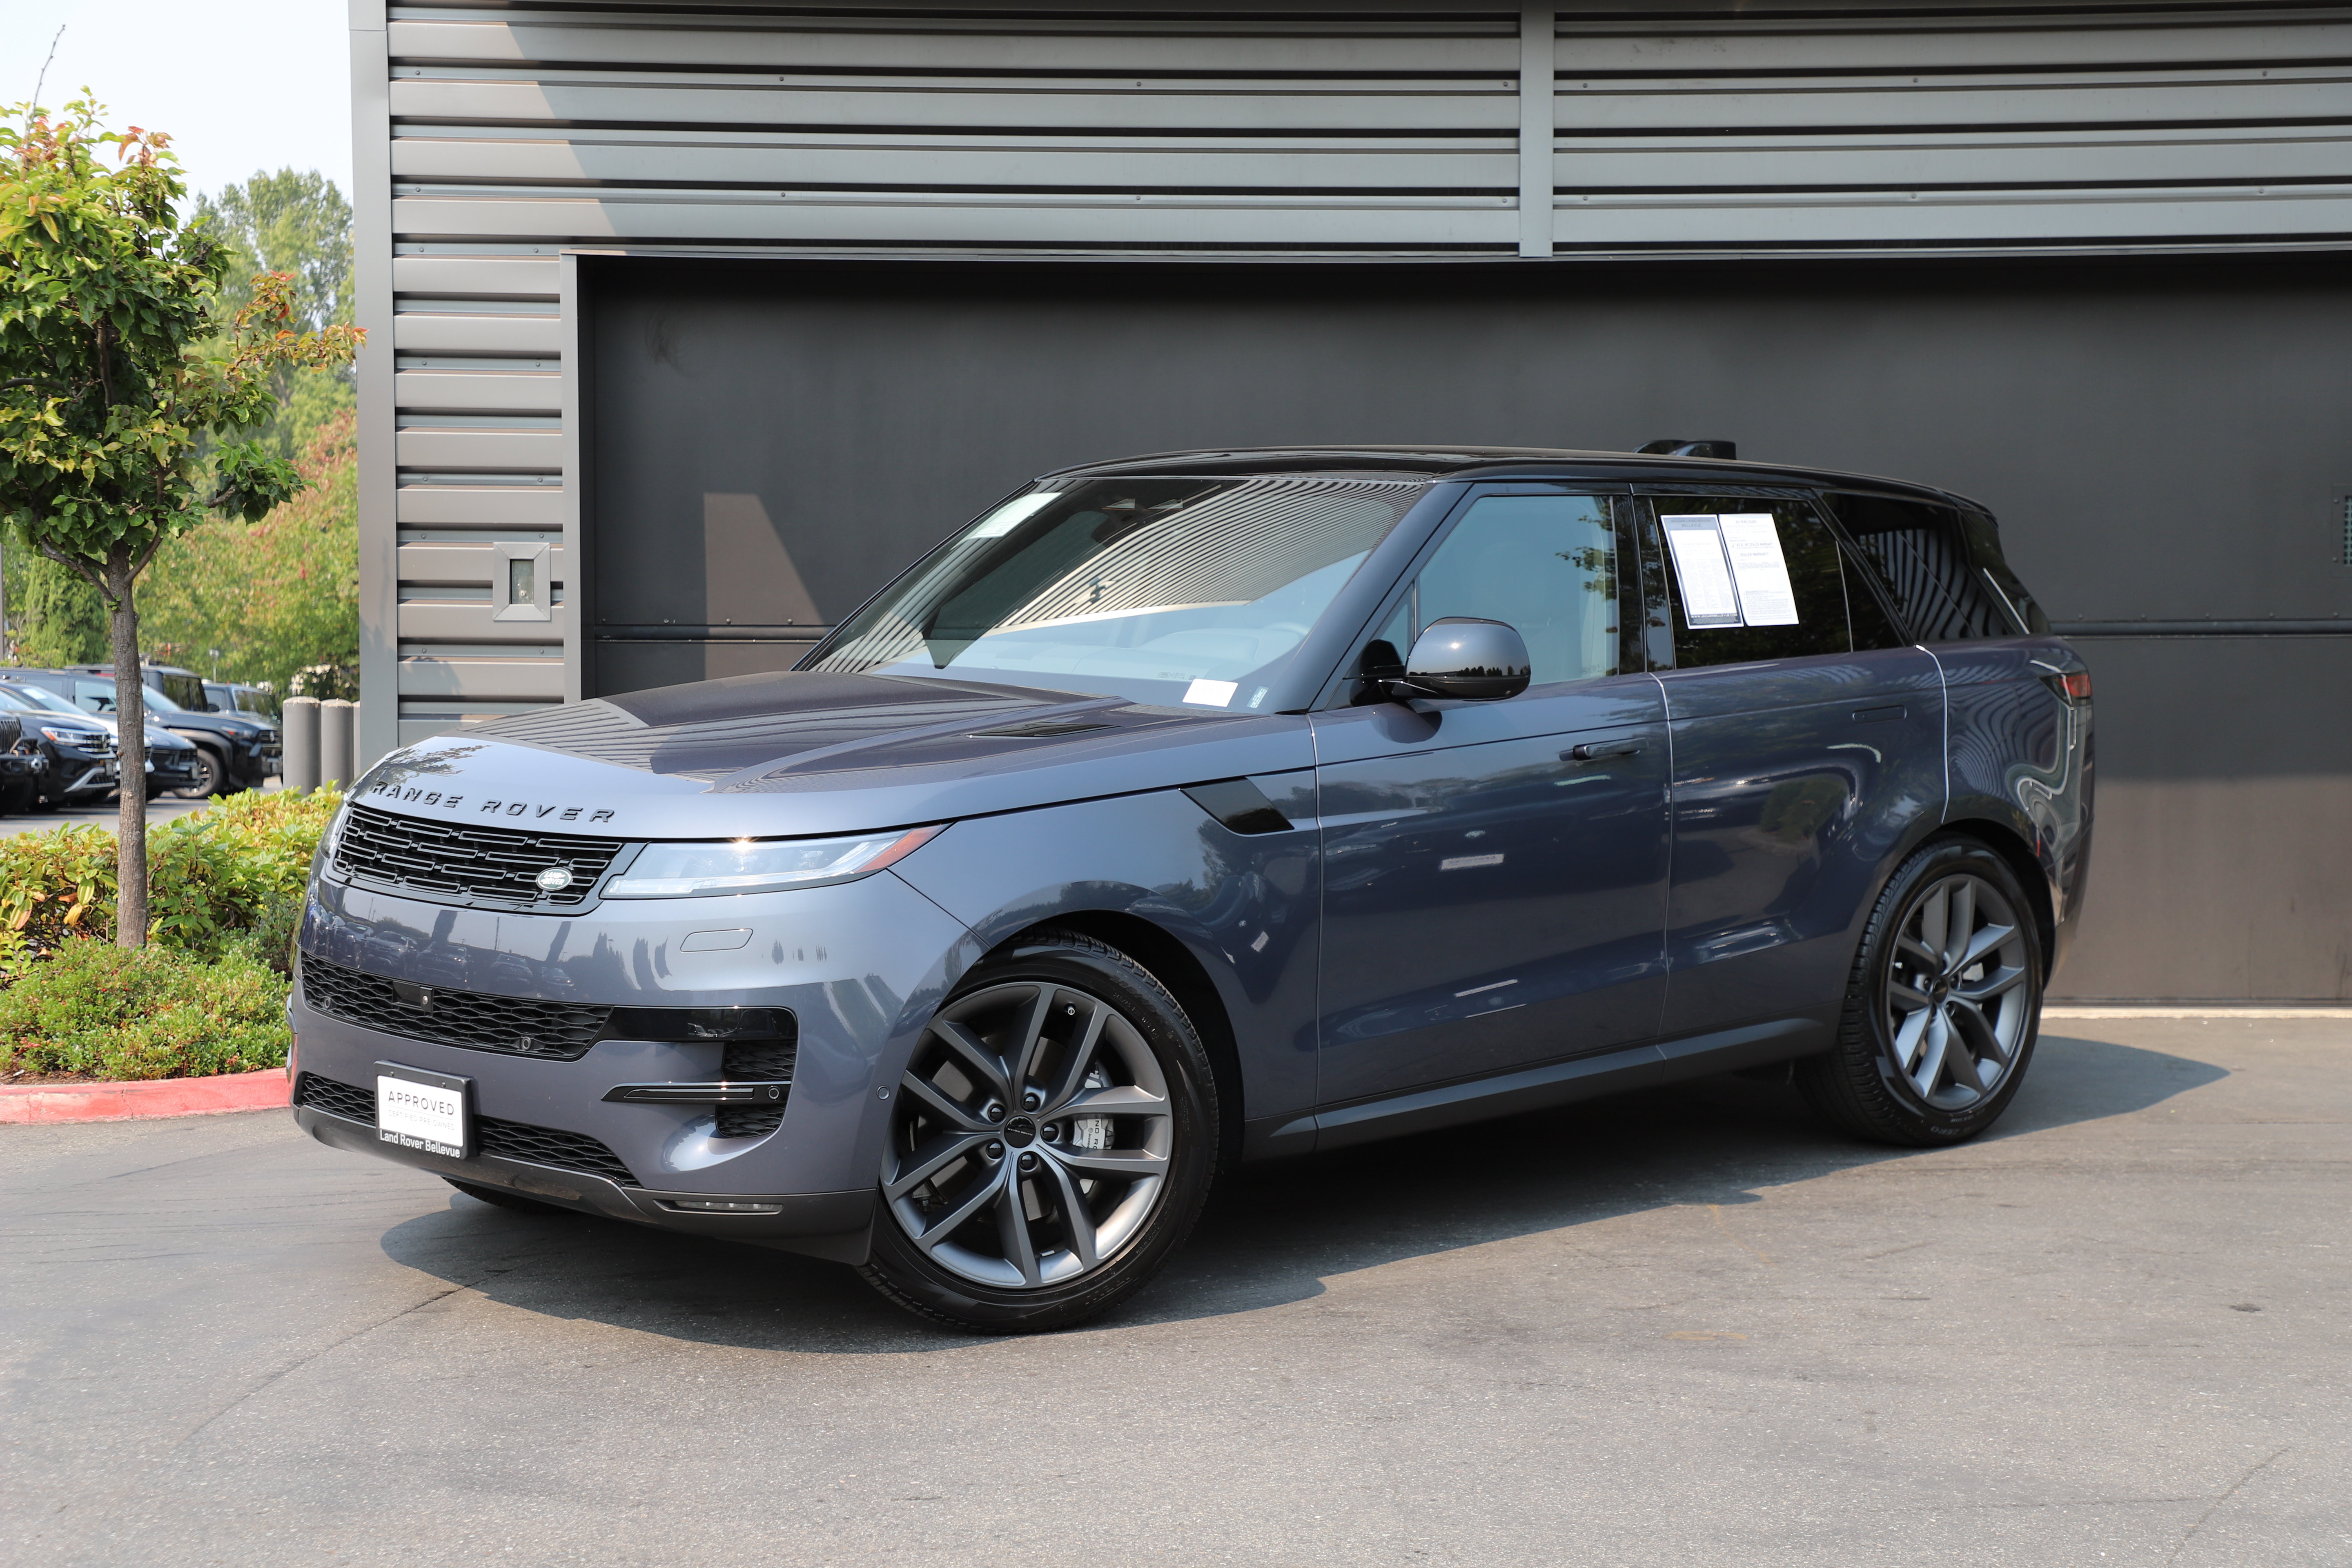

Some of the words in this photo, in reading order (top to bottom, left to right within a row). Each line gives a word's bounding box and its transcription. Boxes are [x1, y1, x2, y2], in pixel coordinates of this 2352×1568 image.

[372, 781, 464, 808] RANGE
[479, 799, 615, 822] ROVER
[388, 1091, 454, 1115] APPROVED
[388, 1109, 418, 1122] CERTIFIED
[419, 1117, 455, 1131] PRE-OWNED
[380, 1129, 399, 1144] Land
[400, 1133, 424, 1150] Rover
[425, 1139, 460, 1158] Bellevue
